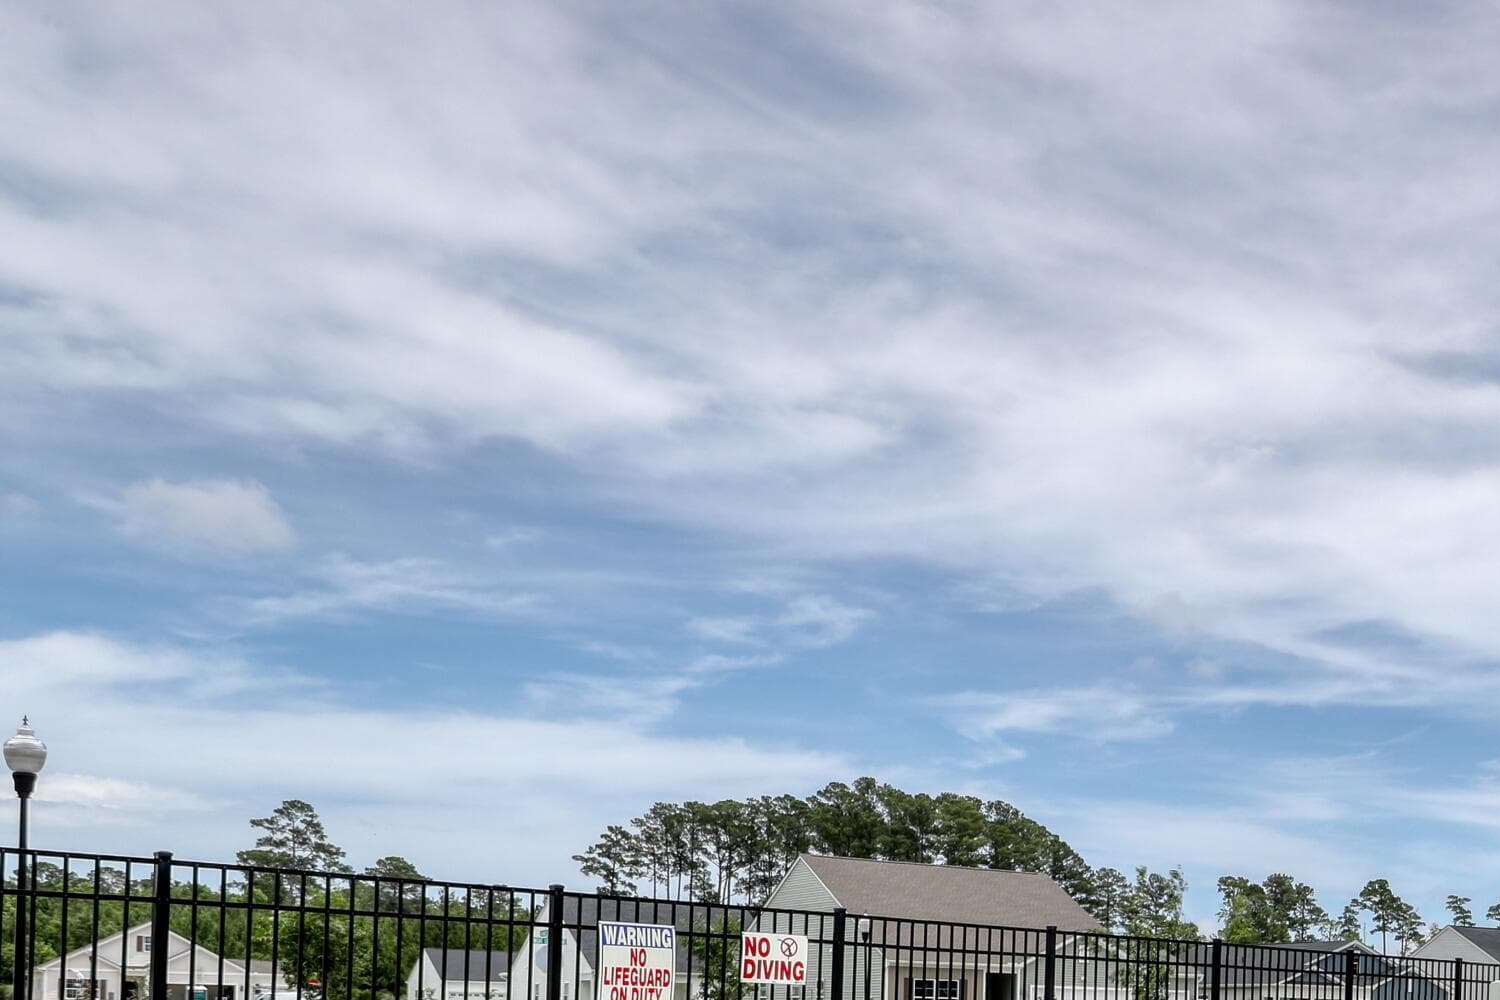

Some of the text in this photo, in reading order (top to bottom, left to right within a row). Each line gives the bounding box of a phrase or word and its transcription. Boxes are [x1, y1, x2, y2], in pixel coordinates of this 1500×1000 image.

[603, 925, 672, 948] WARNING
[744, 936, 771, 958] NO
[630, 948, 647, 967] NO
[603, 966, 671, 987] LIFEGUARD
[743, 958, 805, 982] DIVING
